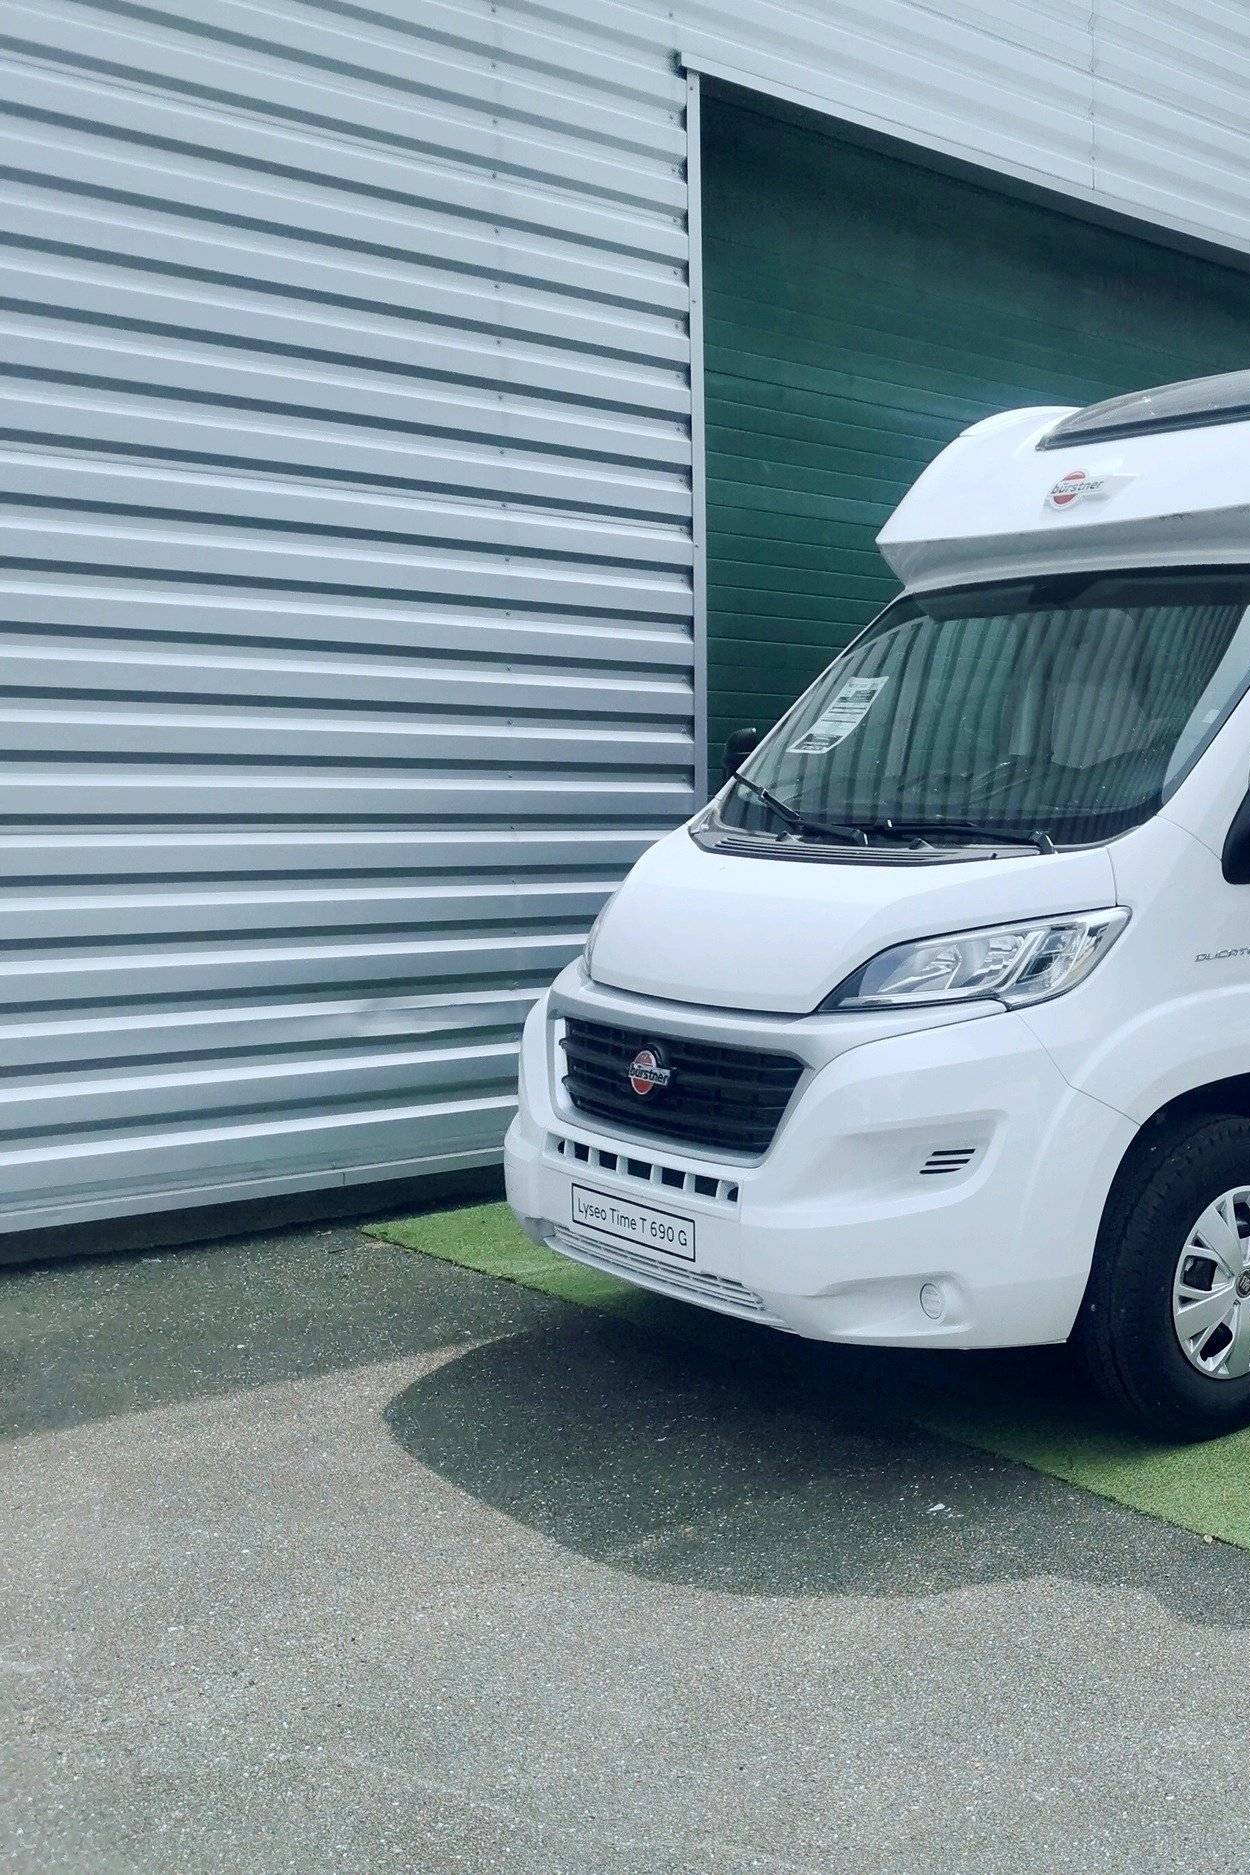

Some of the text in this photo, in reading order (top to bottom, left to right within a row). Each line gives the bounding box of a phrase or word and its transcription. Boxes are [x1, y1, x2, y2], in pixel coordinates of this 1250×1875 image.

[577, 1197, 688, 1247] Lyseo Time T 690 G
